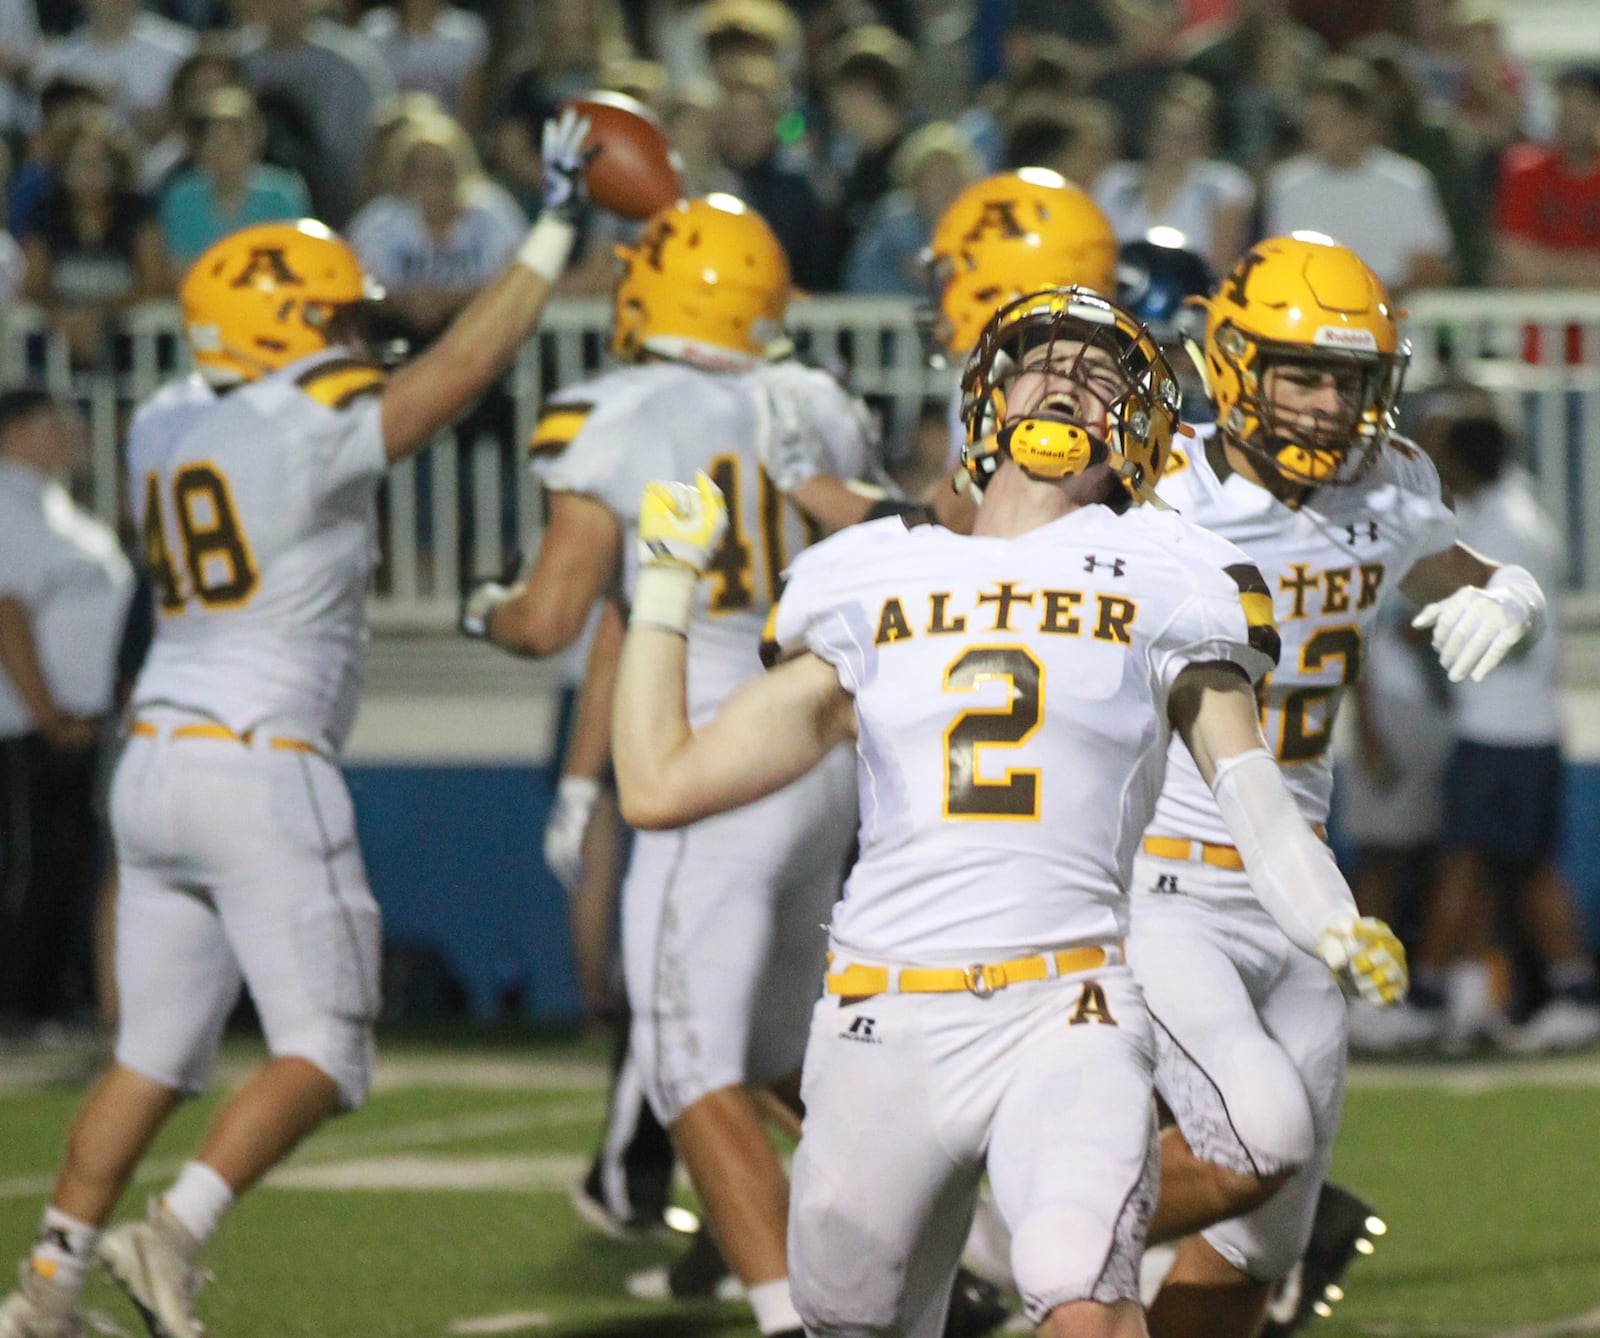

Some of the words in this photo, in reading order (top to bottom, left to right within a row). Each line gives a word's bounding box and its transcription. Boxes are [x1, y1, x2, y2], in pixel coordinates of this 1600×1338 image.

[231, 246, 304, 288] A
[874, 580, 1137, 648] ALTER
[1255, 623, 1361, 765] 2
[942, 644, 1046, 821] 2
[1067, 979, 1119, 1026] A
